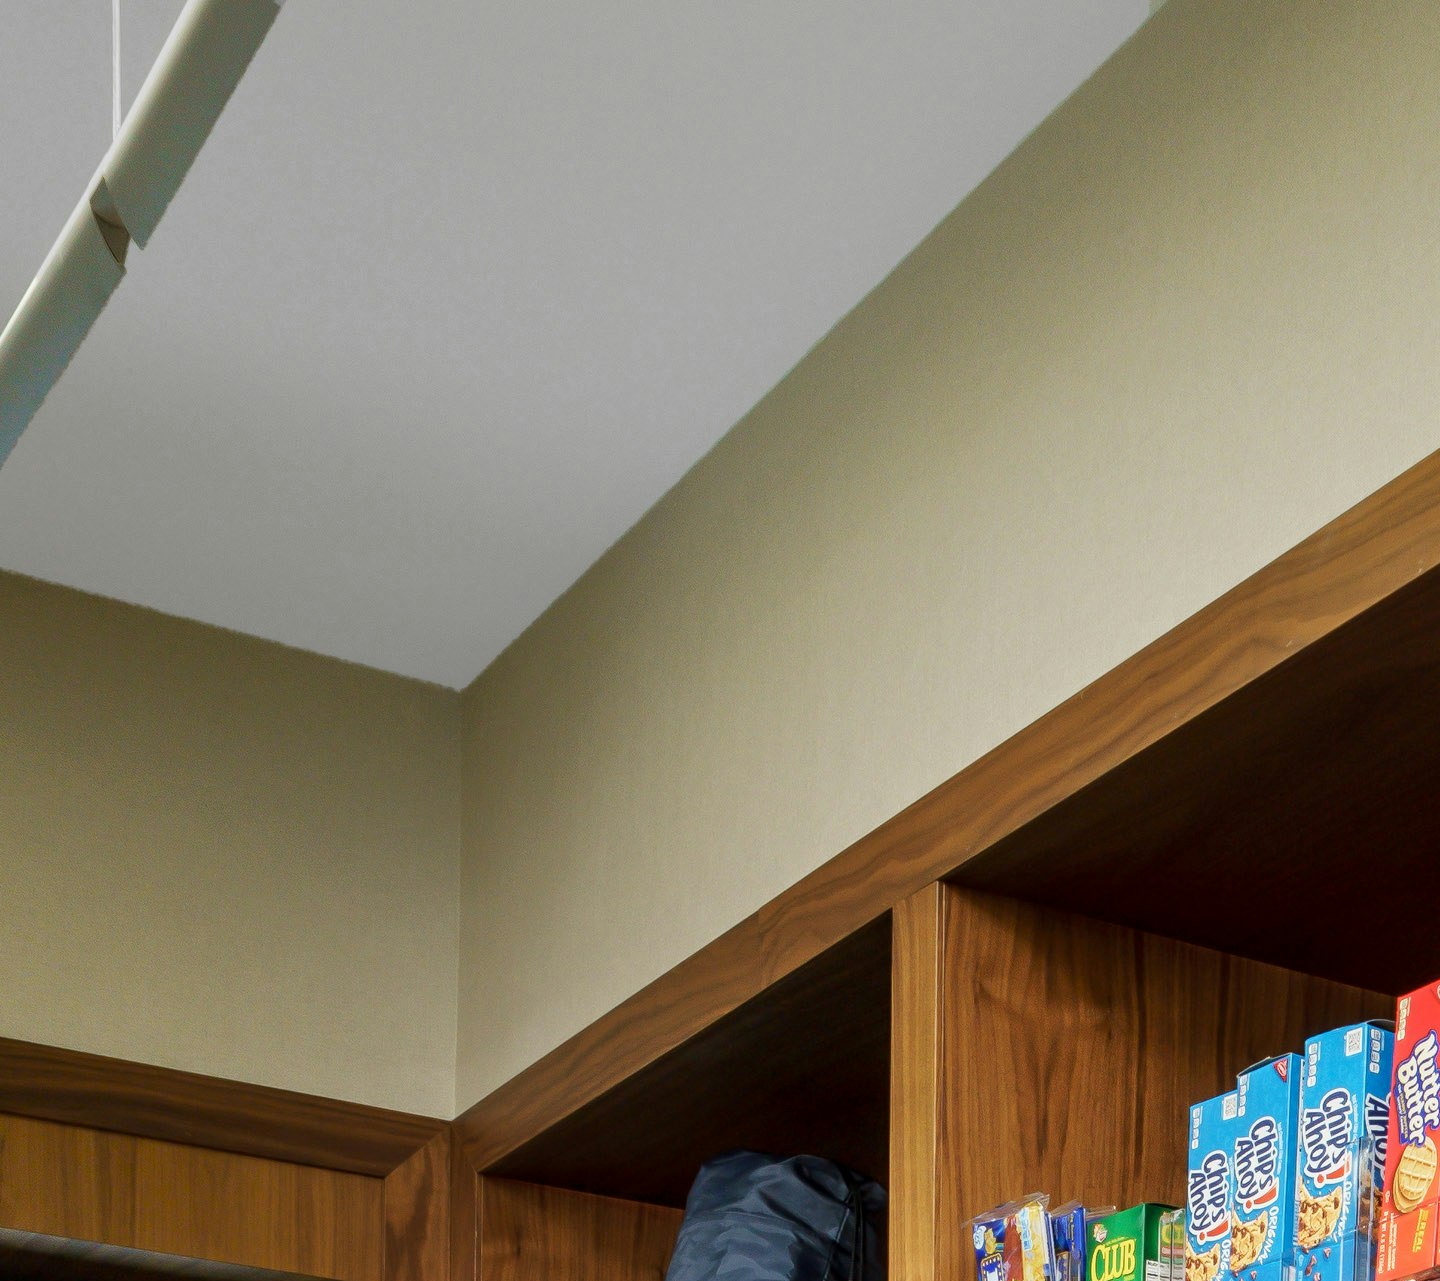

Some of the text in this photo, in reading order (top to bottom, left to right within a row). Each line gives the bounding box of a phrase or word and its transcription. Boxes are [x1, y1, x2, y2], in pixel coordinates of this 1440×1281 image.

[1397, 1057, 1424, 1146] Butter
[1414, 1033, 1440, 1127] Nutter
[1250, 1118, 1274, 1191] Chips
[1322, 1091, 1348, 1163] Chips
[1204, 1152, 1226, 1223] Chips
